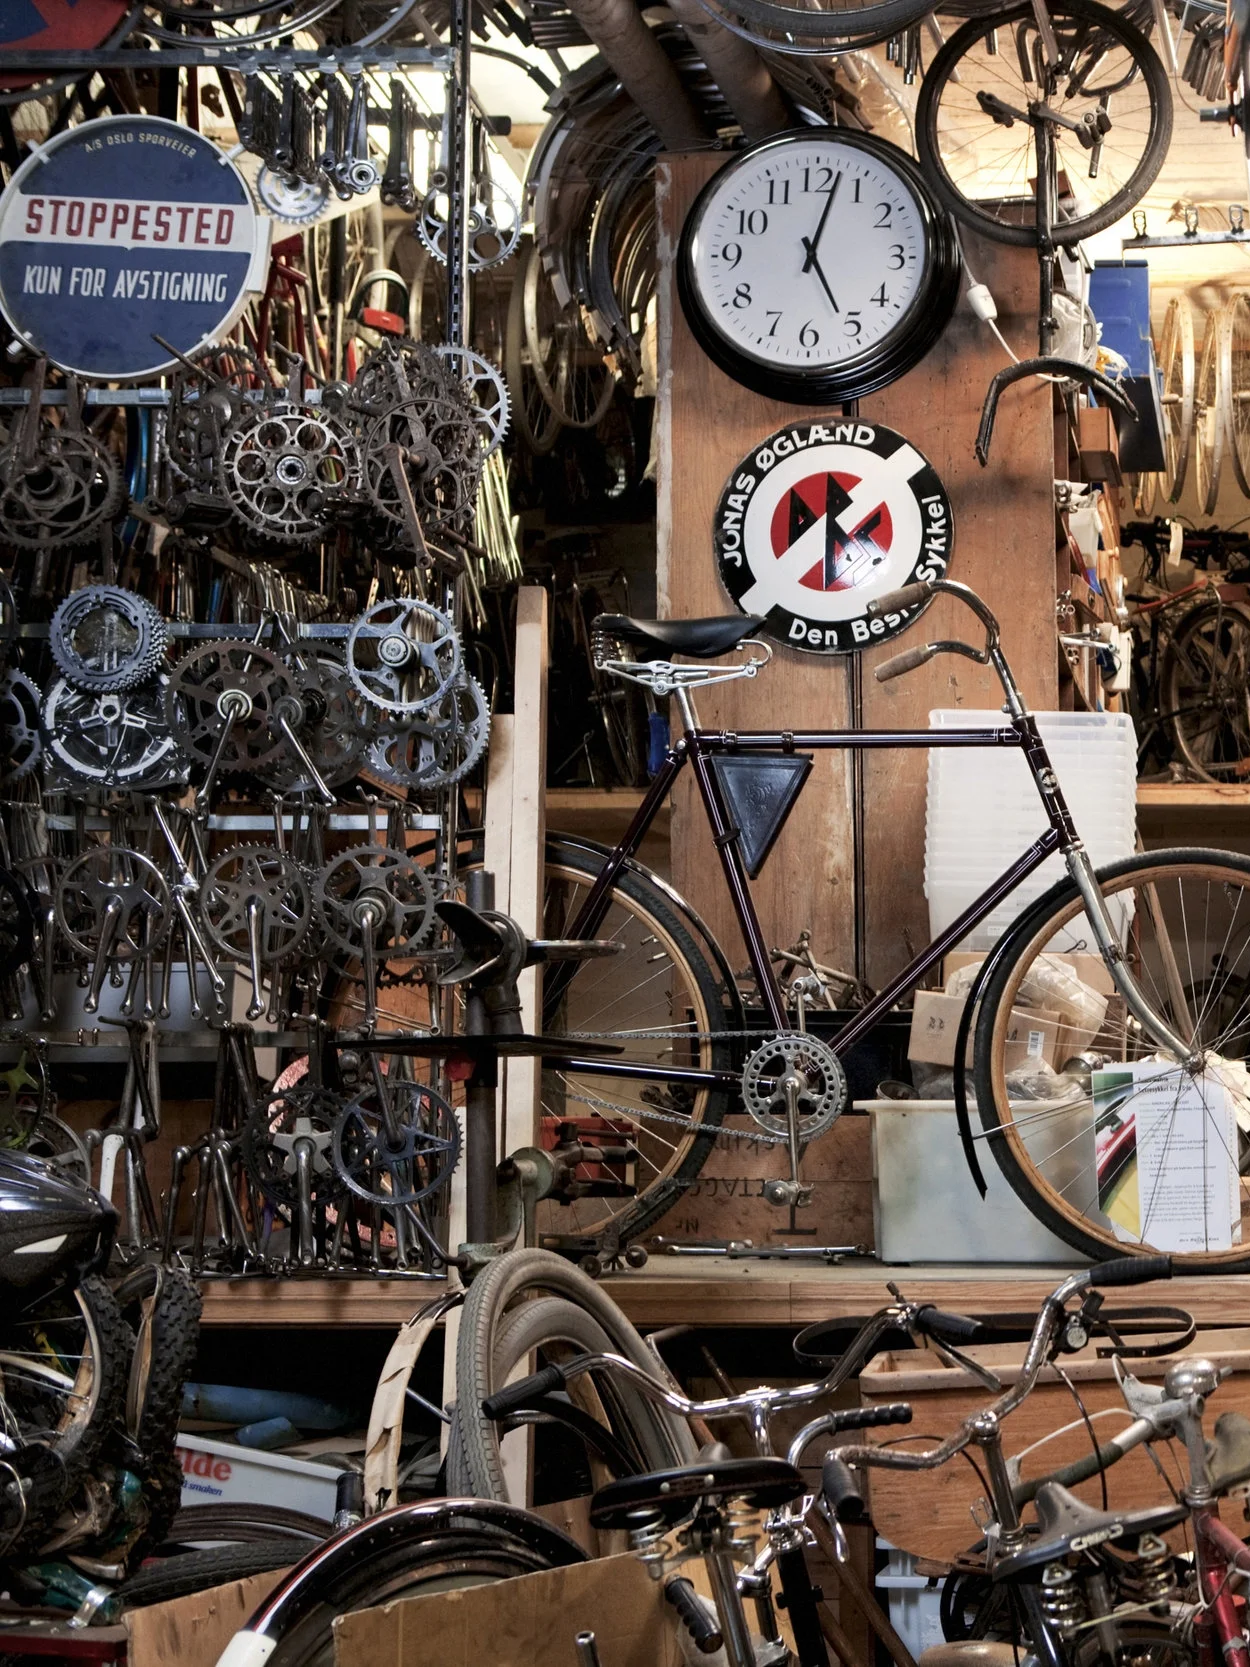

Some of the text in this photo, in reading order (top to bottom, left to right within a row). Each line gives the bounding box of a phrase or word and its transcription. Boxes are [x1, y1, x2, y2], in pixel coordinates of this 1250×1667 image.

[106, 132, 134, 145] OSLO
[139, 132, 197, 159] SPORVEIER
[765, 179, 793, 205] 11
[800, 167, 833, 193] 12
[851, 178, 863, 203] 1
[25, 198, 235, 246] STOPPESTED
[735, 208, 768, 235] 10
[873, 202, 892, 229] 2
[721, 243, 742, 271] 9
[886, 244, 905, 270] 3
[23, 265, 228, 302] KUN FOR AVSTIGNING
[732, 283, 752, 309] 8
[870, 281, 889, 307] 4
[766, 311, 783, 337] 7
[799, 319, 820, 348] 6
[843, 311, 862, 337] 5
[722, 473, 756, 567] JONAS
[788, 617, 838, 646] Den
[915, 494, 947, 583] Sykkel
